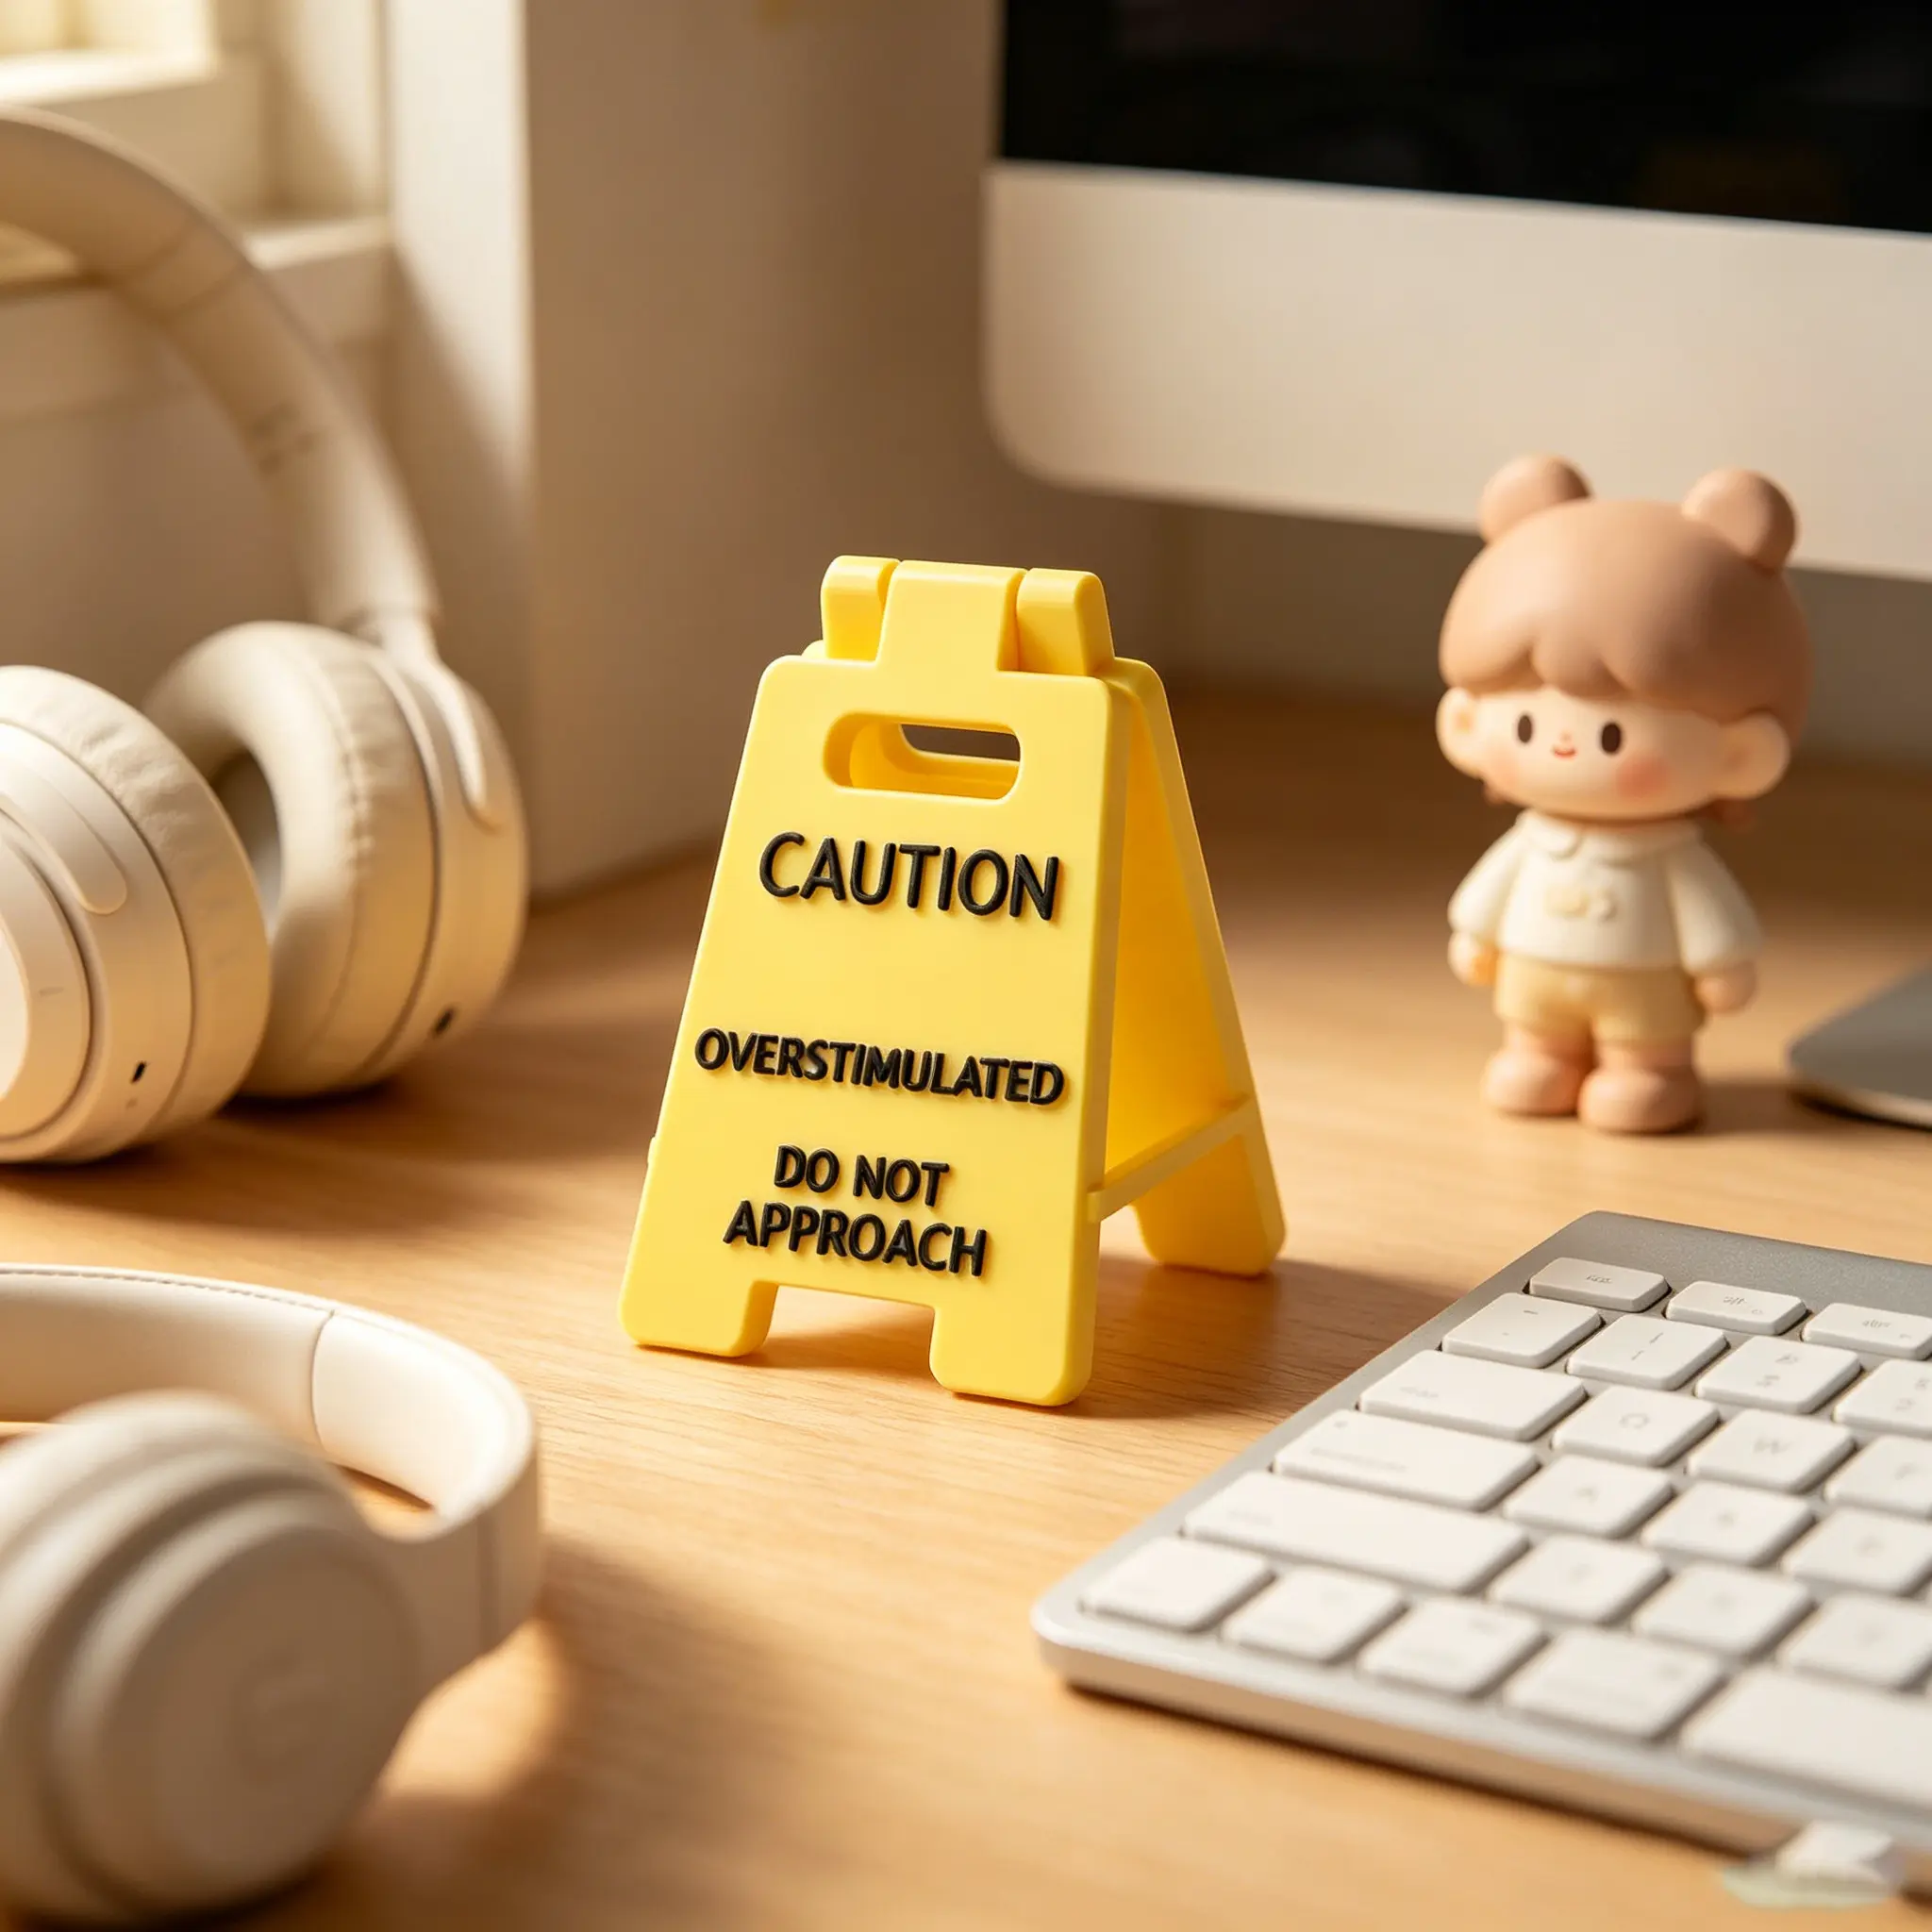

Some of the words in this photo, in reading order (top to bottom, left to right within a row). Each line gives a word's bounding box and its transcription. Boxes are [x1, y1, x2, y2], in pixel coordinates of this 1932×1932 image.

[759, 832, 1058, 921] CAUTION
[695, 1027, 1064, 1106] OVERSTIMULATED
[774, 1144, 840, 1193] DO
[853, 1155, 950, 1207] NOT
[723, 1200, 987, 1276] APPROACH
